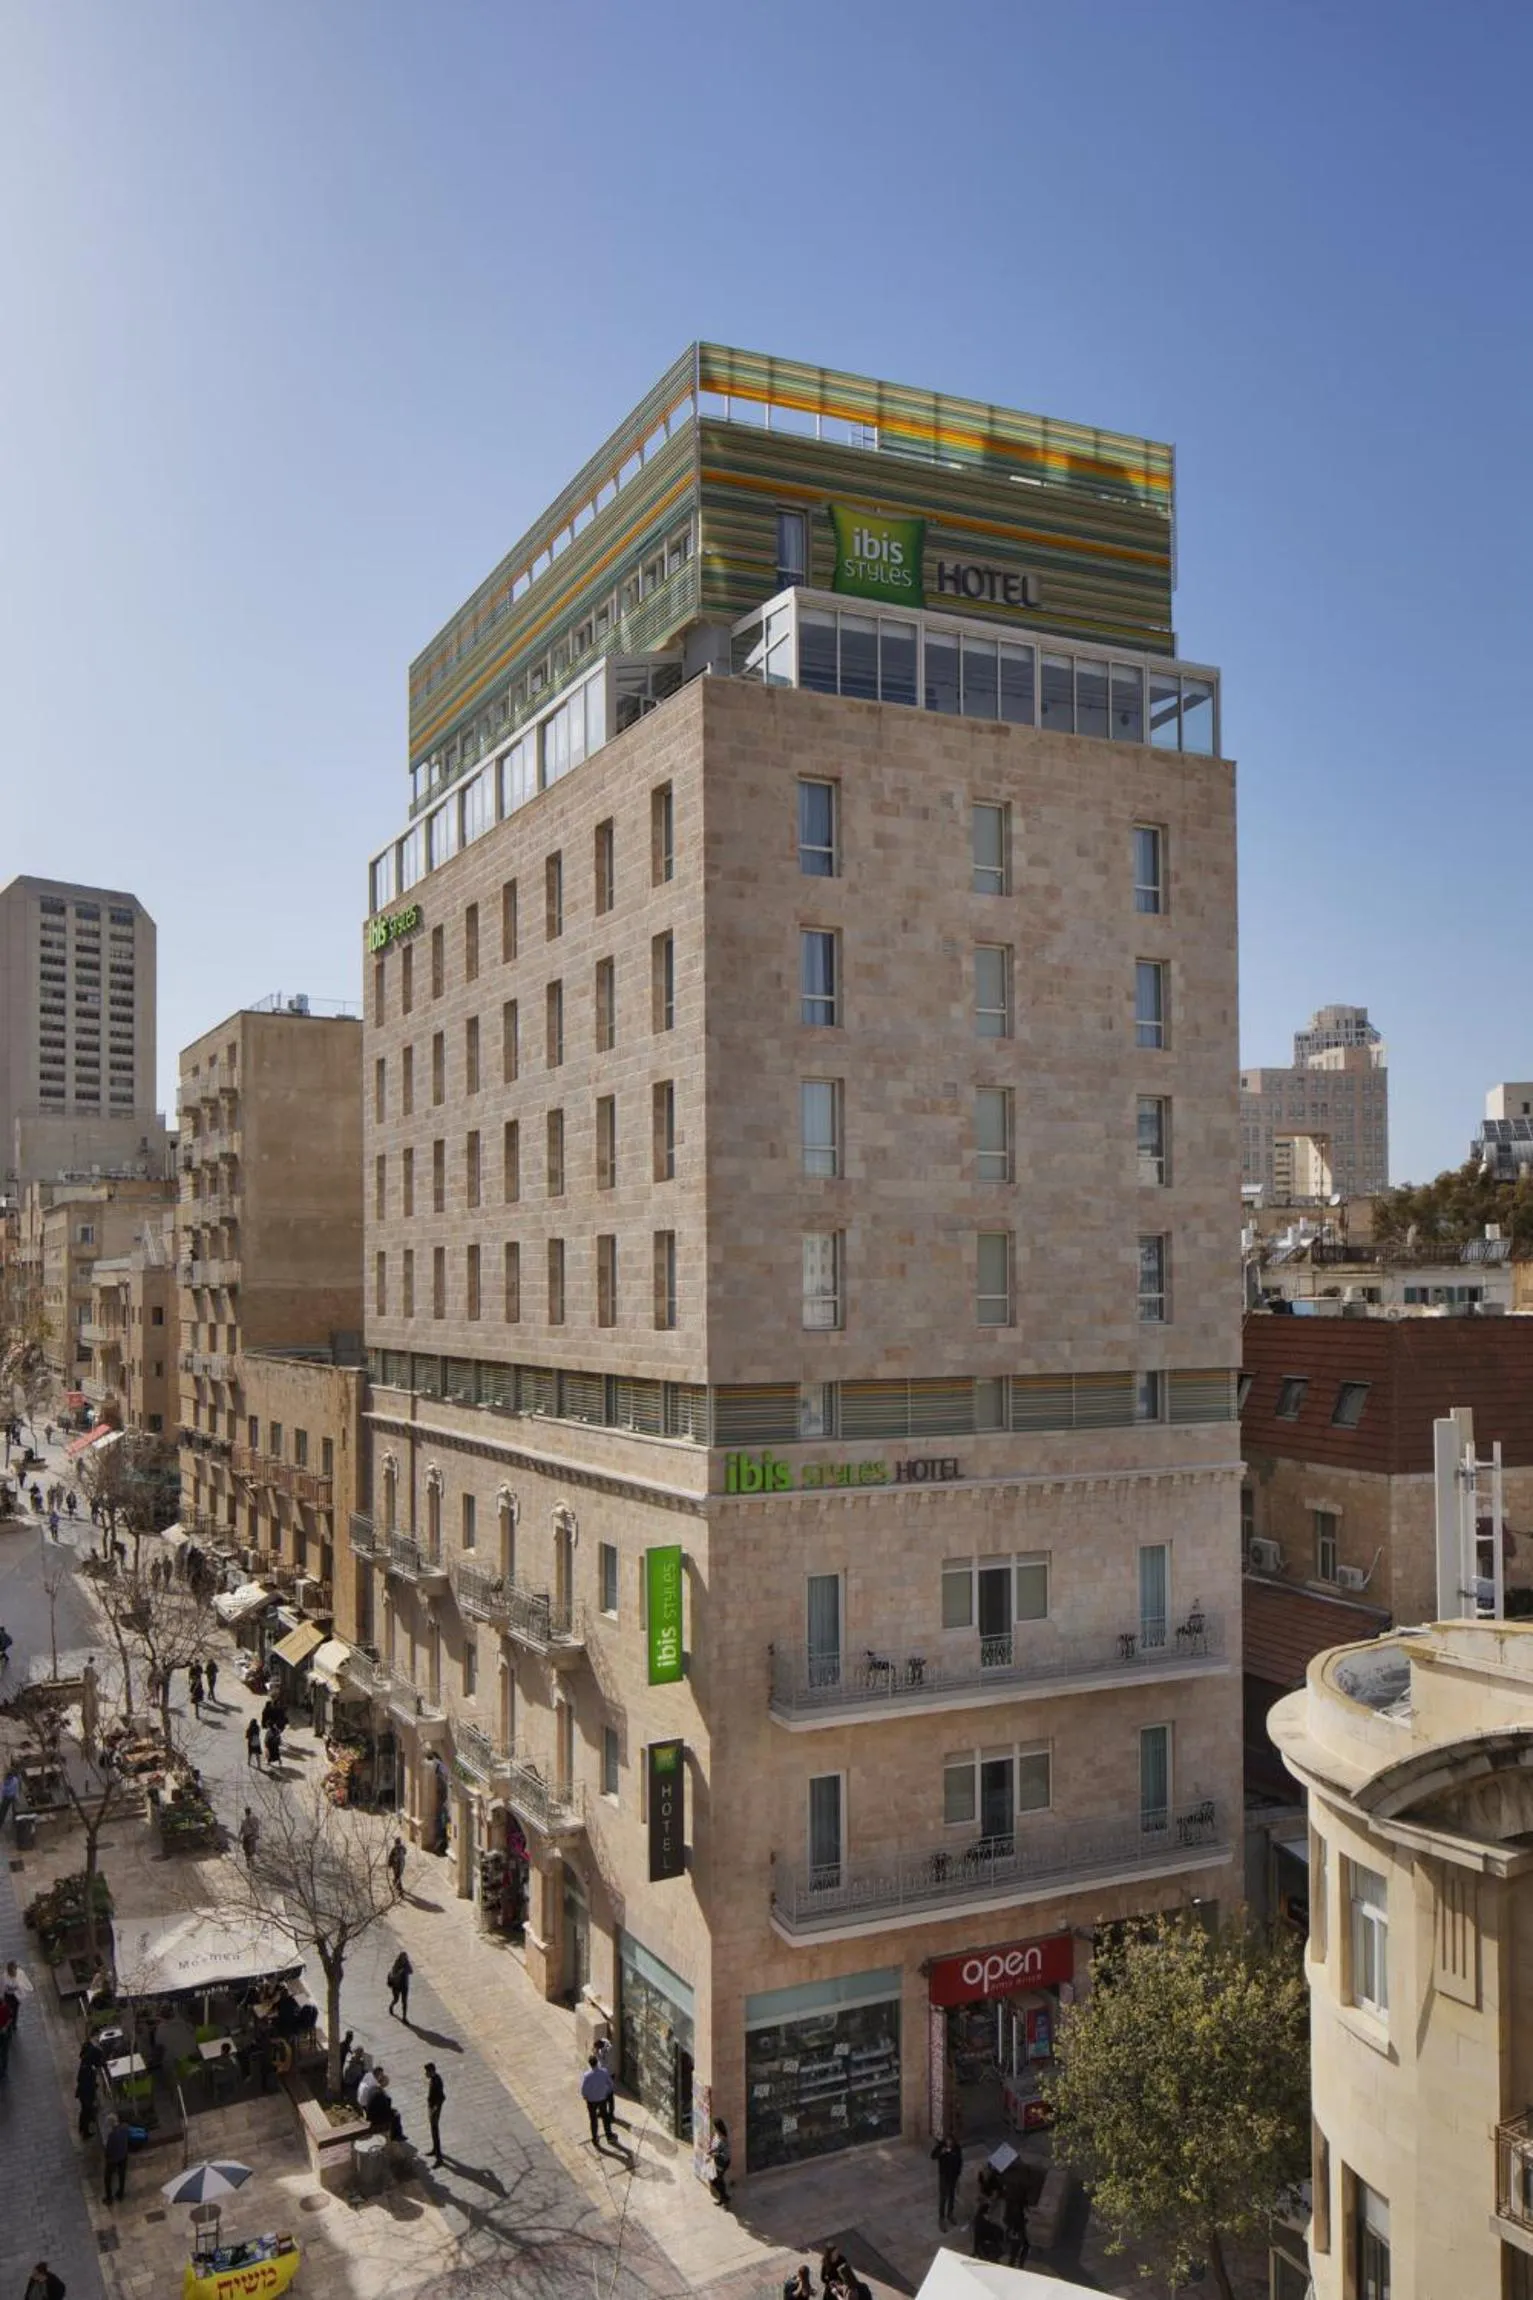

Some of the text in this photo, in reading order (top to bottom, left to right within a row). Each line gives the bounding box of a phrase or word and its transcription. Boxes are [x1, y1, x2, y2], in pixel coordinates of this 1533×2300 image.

[852, 527, 904, 565] ibis
[937, 561, 1041, 608] HOTEL
[725, 1449, 794, 1495] ibis
[895, 1457, 966, 1483] HOTEL
[656, 1626, 677, 1668] ibis
[661, 1784, 673, 1869] HOTEL
[962, 1946, 1042, 1994] open
[216, 2266, 277, 2300] משיח
